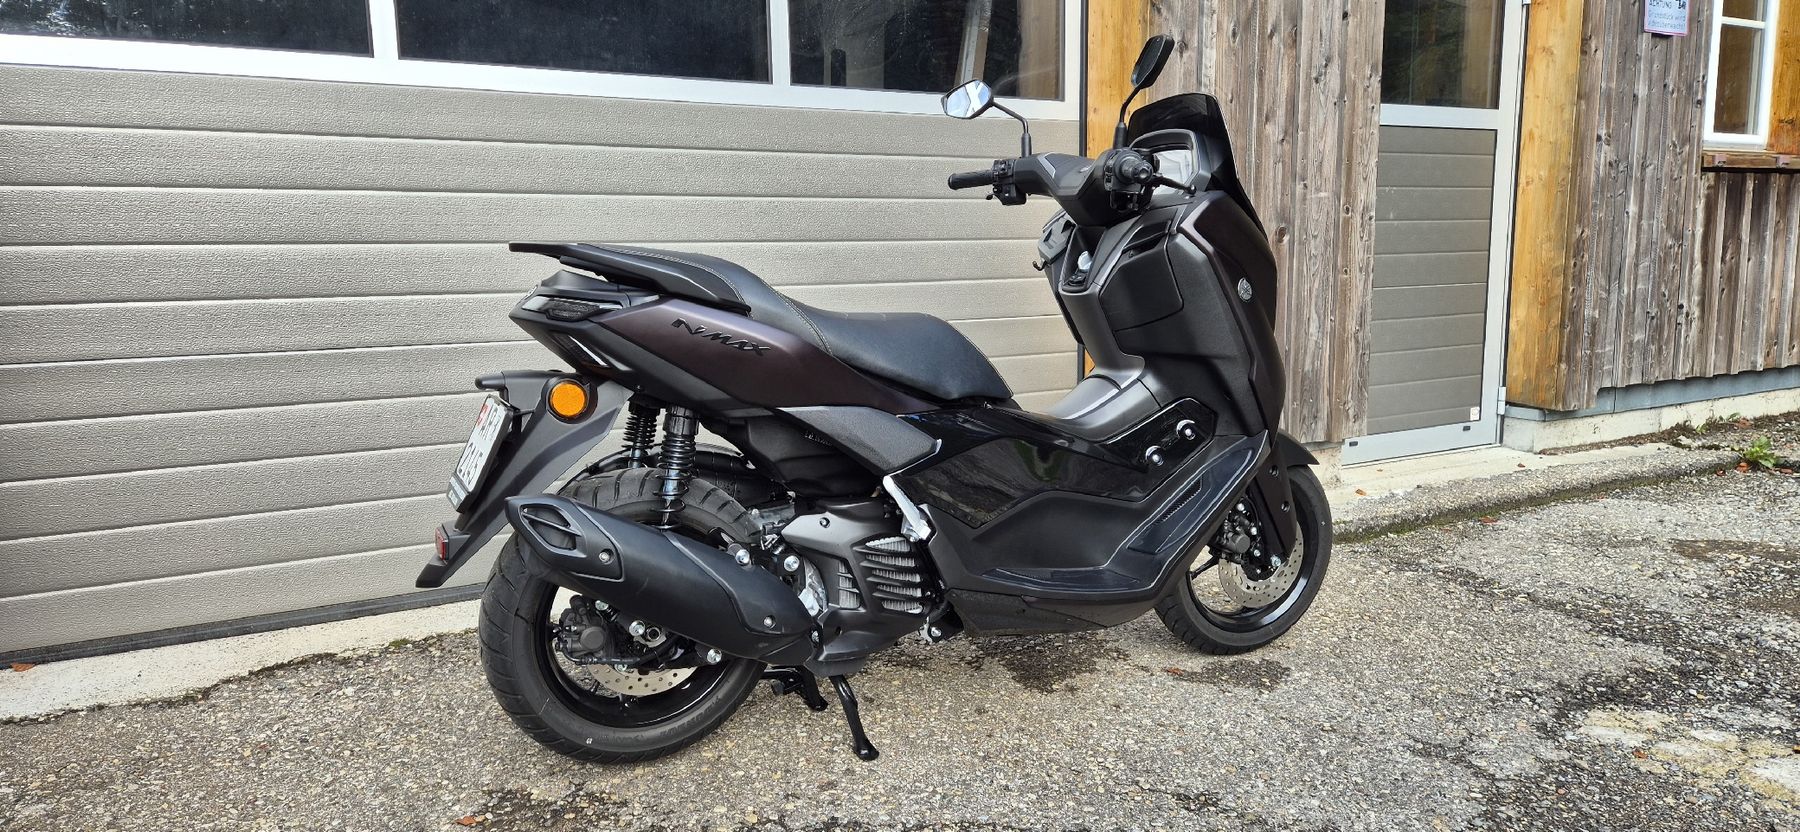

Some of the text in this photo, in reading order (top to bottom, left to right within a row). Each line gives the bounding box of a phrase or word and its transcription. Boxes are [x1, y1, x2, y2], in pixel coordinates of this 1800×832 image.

[671, 317, 771, 356] NMAX
[478, 404, 499, 441] AR
[459, 441, 484, 486] 2145
